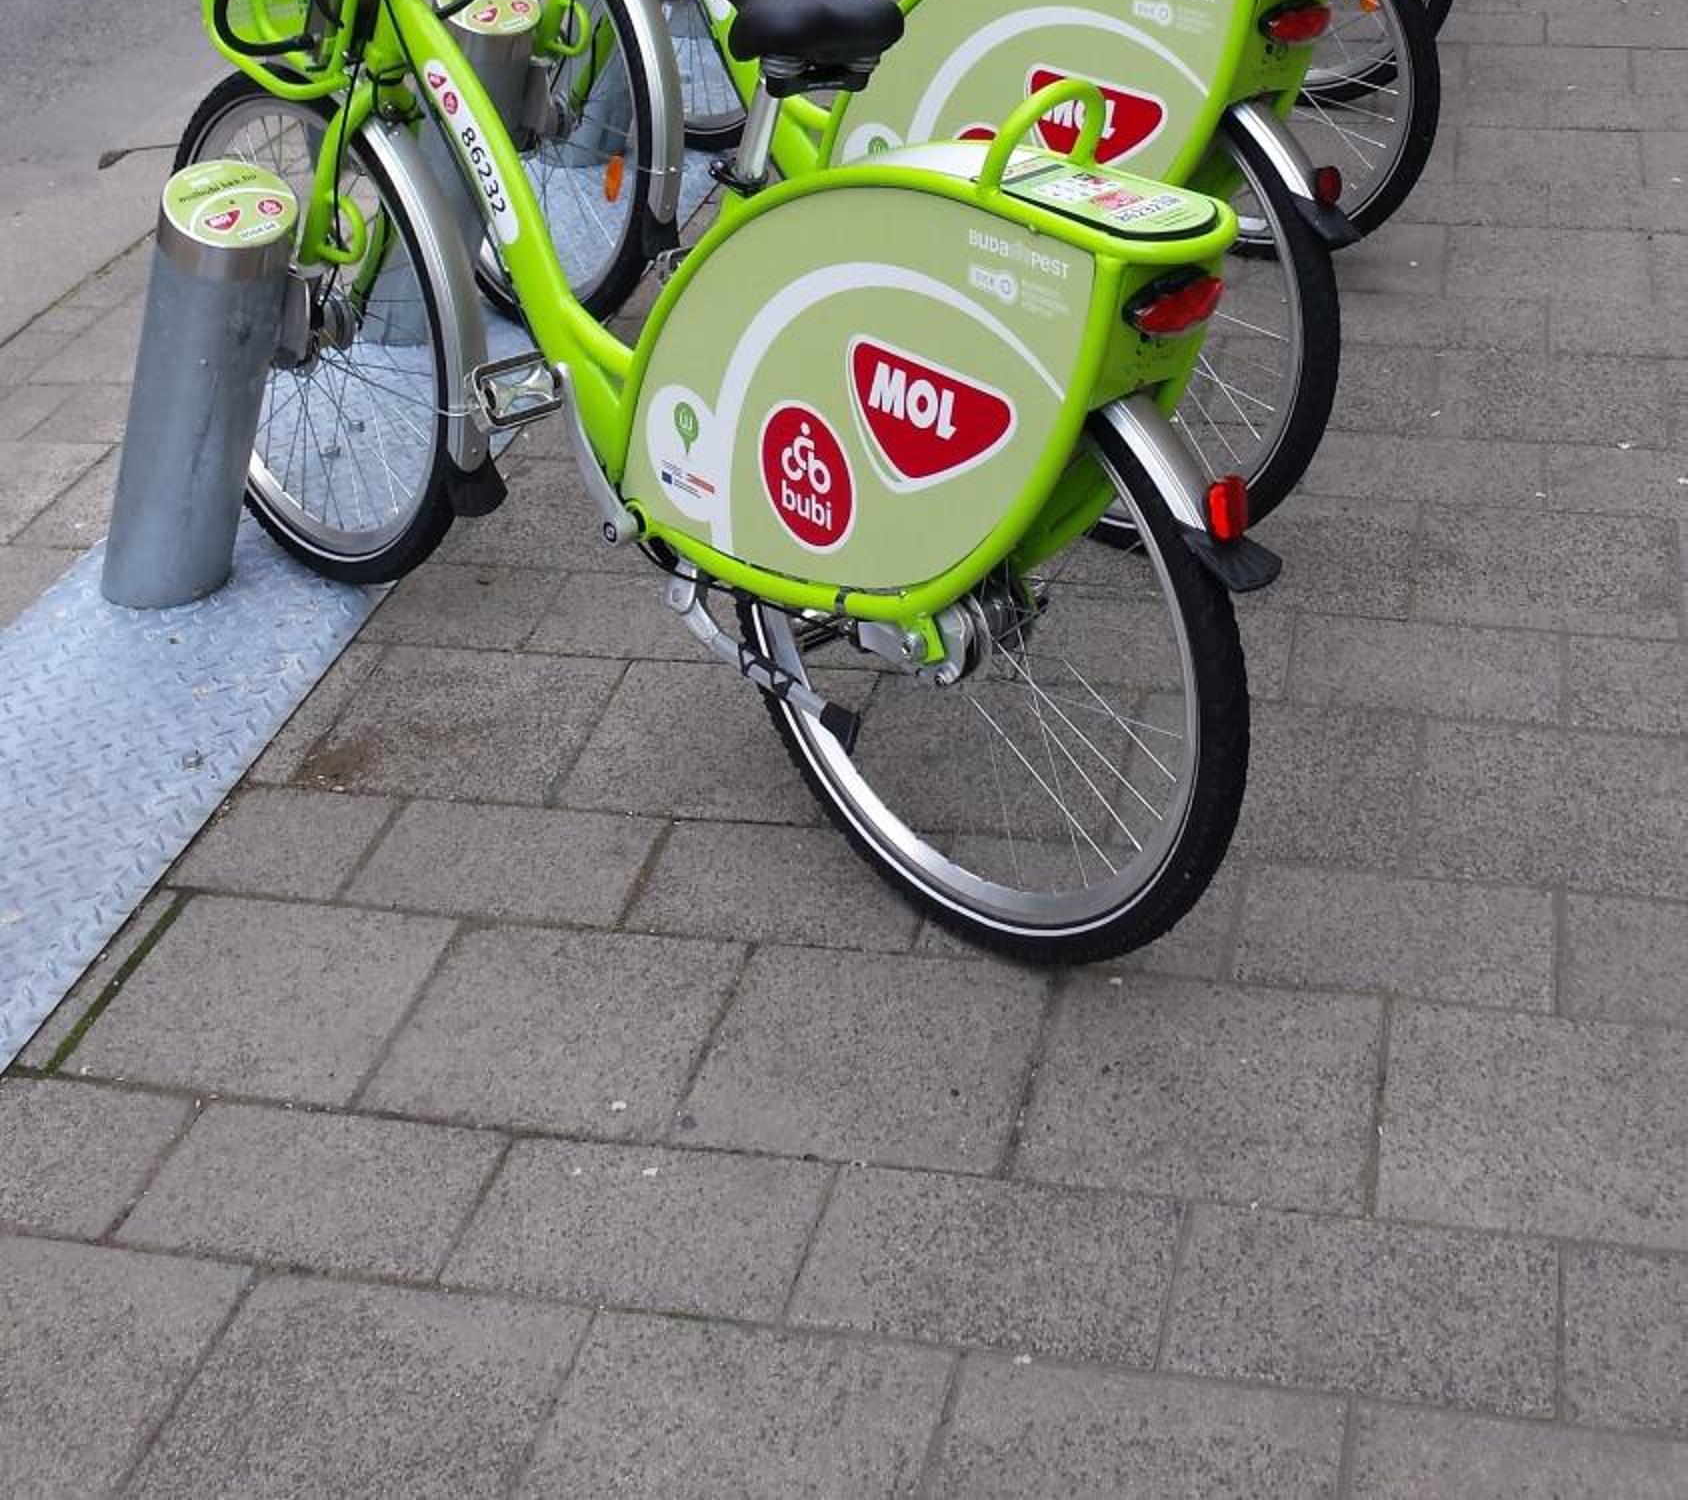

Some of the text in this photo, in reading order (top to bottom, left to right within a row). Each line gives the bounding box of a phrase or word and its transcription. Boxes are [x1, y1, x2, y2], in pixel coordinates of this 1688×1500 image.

[461, 126, 507, 216] 86232
[867, 361, 957, 441] MOL
[781, 479, 833, 531] bubi
